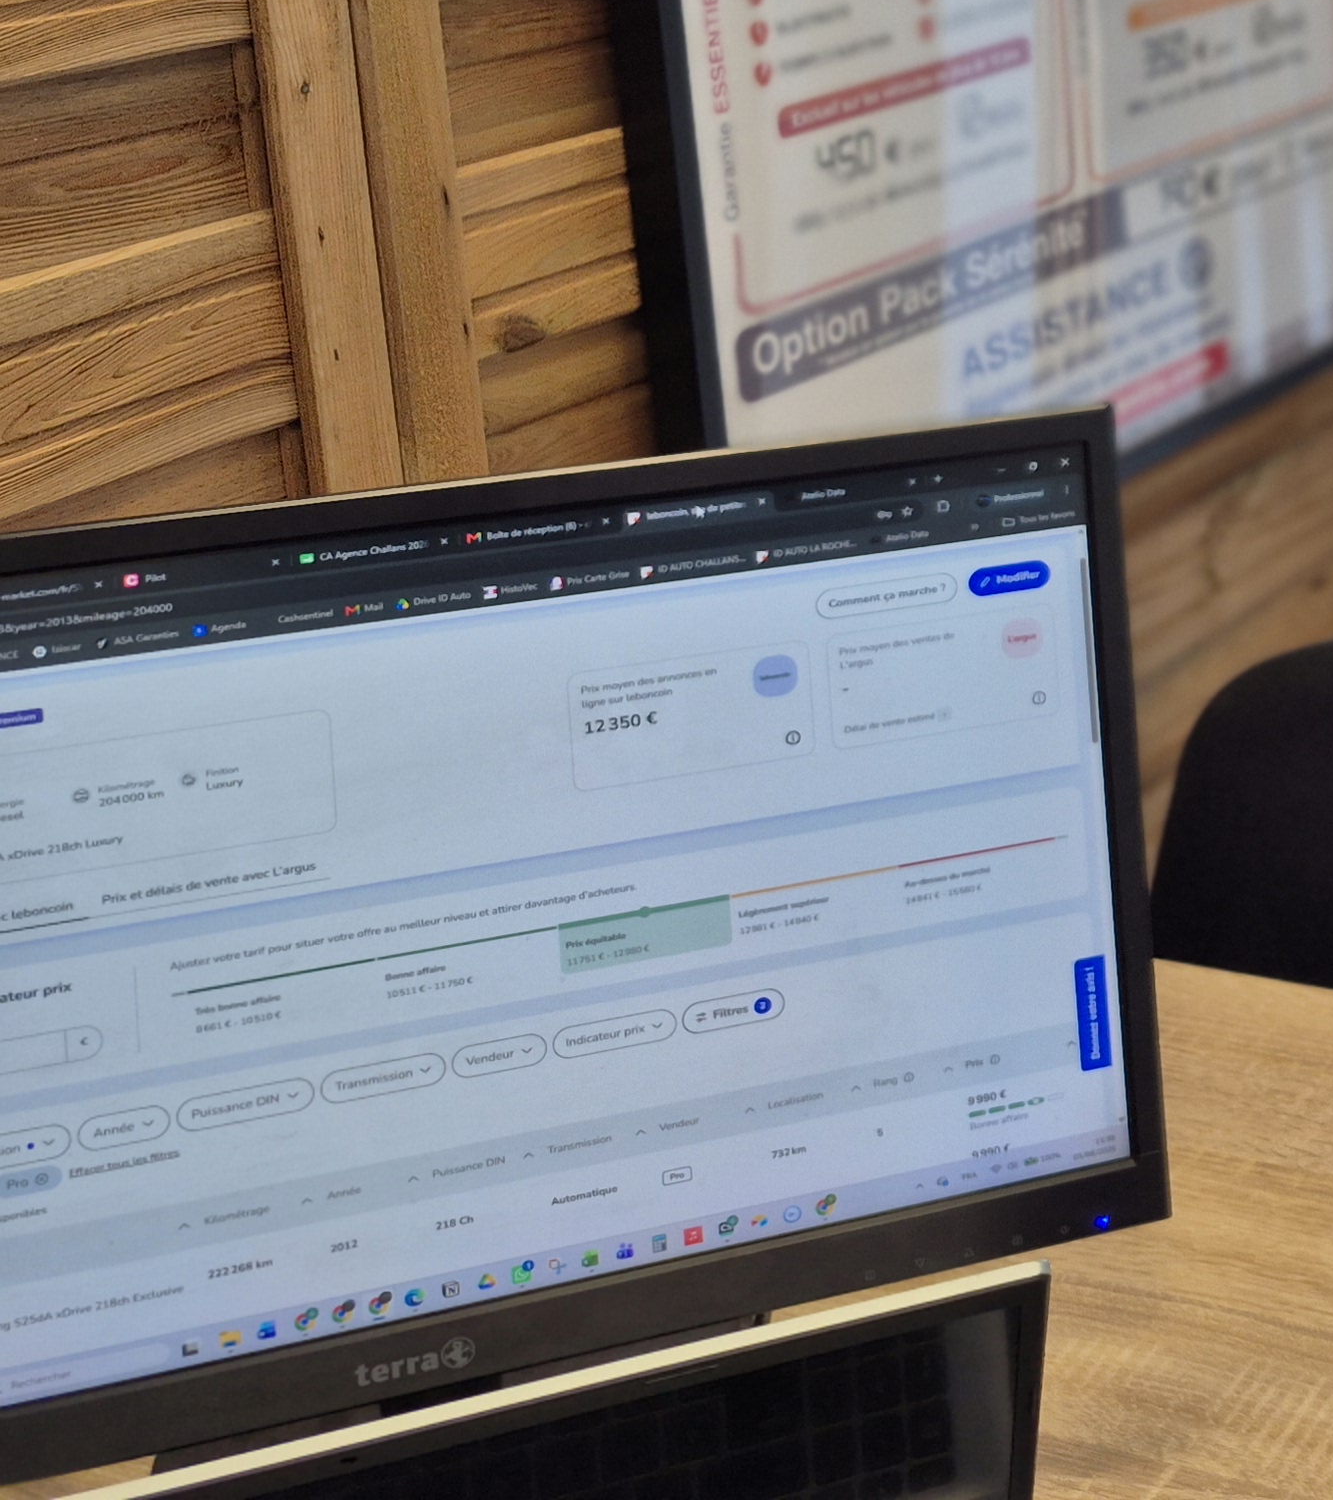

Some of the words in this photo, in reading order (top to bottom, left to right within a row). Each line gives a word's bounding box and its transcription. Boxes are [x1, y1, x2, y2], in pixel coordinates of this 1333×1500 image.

[753, 304, 870, 375] Option
[879, 271, 956, 324] Pack
[319, 551, 334, 562] CA
[335, 546, 368, 561] Agence
[670, 560, 693, 573] AUTO
[145, 572, 167, 584] Pilot
[567, 575, 581, 586] Prix
[584, 571, 607, 584] Carte
[608, 569, 630, 581] Grise
[996, 570, 1040, 585] Modifier
[413, 594, 436, 607] Drive
[438, 592, 448, 602] ID
[450, 590, 471, 602] Auto
[828, 592, 881, 609] Comment
[884, 590, 897, 603] ça
[898, 584, 938, 598] marche
[364, 601, 384, 613] Mail
[278, 608, 334, 624] Cashsentinel
[211, 620, 247, 634] Agenda
[113, 635, 134, 646] ASA
[136, 629, 180, 643] Garanties
[860, 640, 891, 655] moyen
[581, 684, 600, 695] Prix
[602, 680, 636, 695] moyen
[637, 675, 655, 687] des
[657, 669, 703, 684] annonces
[704, 667, 717, 677] en
[581, 697, 606, 711] ligne
[608, 695, 624, 705] sur
[626, 687, 673, 703] leboncoin
[647, 711, 658, 725] €
[205, 764, 239, 778] Finition
[206, 777, 243, 793] Luxury
[147, 788, 164, 801] km
[7, 845, 45, 861] xDrive
[48, 839, 83, 855] 218ch
[85, 833, 124, 852] Luxury
[101, 892, 127, 905] Prix
[129, 890, 143, 901] et
[145, 882, 184, 898] délais
[186, 879, 202, 891] de
[204, 874, 240, 889] vente
[242, 870, 271, 883] avec
[273, 860, 317, 881] L'argus
[11, 901, 74, 921] leboncoin
[169, 955, 211, 973] Ajustez
[212, 951, 241, 965] votre
[243, 945, 266, 959] tarif
[268, 942, 293, 958] pour
[296, 935, 325, 950] situer
[327, 930, 354, 945] votre
[357, 925, 381, 939] offre
[384, 924, 397, 934] au
[399, 916, 441, 932] meilleur
[443, 911, 477, 925] niveau
[479, 907, 490, 918] et
[492, 902, 522, 916] attirer
[524, 893, 577, 911] davantage
[565, 939, 583, 950] Prix
[585, 931, 627, 948] équitable
[416, 964, 447, 977] affaire
[43, 980, 72, 997] prix
[713, 1004, 749, 1020] Filtres
[80, 1035, 89, 1047] €
[565, 1029, 622, 1048] Indicateur
[624, 1023, 646, 1040] prix
[465, 1048, 514, 1067] Vendeur
[335, 1068, 413, 1092] Transmission
[191, 1101, 253, 1120] Puissance
[255, 1093, 280, 1108] DIN
[767, 1090, 824, 1111] Localisation
[93, 1121, 135, 1139] Année
[659, 1116, 700, 1132] Vendeur
[547, 1133, 613, 1155] Transmission
[771, 1147, 790, 1159] 732
[791, 1143, 807, 1155] km
[107, 1158, 131, 1171] tous
[432, 1161, 483, 1180] Puissance
[485, 1155, 506, 1168] DIN
[6, 1177, 28, 1191] Pro
[669, 1170, 685, 1181] Pro
[326, 1184, 362, 1201] Année
[551, 1184, 619, 1207] Automatique
[204, 1203, 271, 1228] Kilométrage
[435, 1218, 457, 1231] 218
[459, 1214, 474, 1225] Ch
[330, 1239, 359, 1253] 2012
[255, 1257, 273, 1270] km
[55, 1302, 93, 1321] xDrive
[132, 1283, 185, 1303] Exclusive
[354, 1351, 440, 1388] terra
